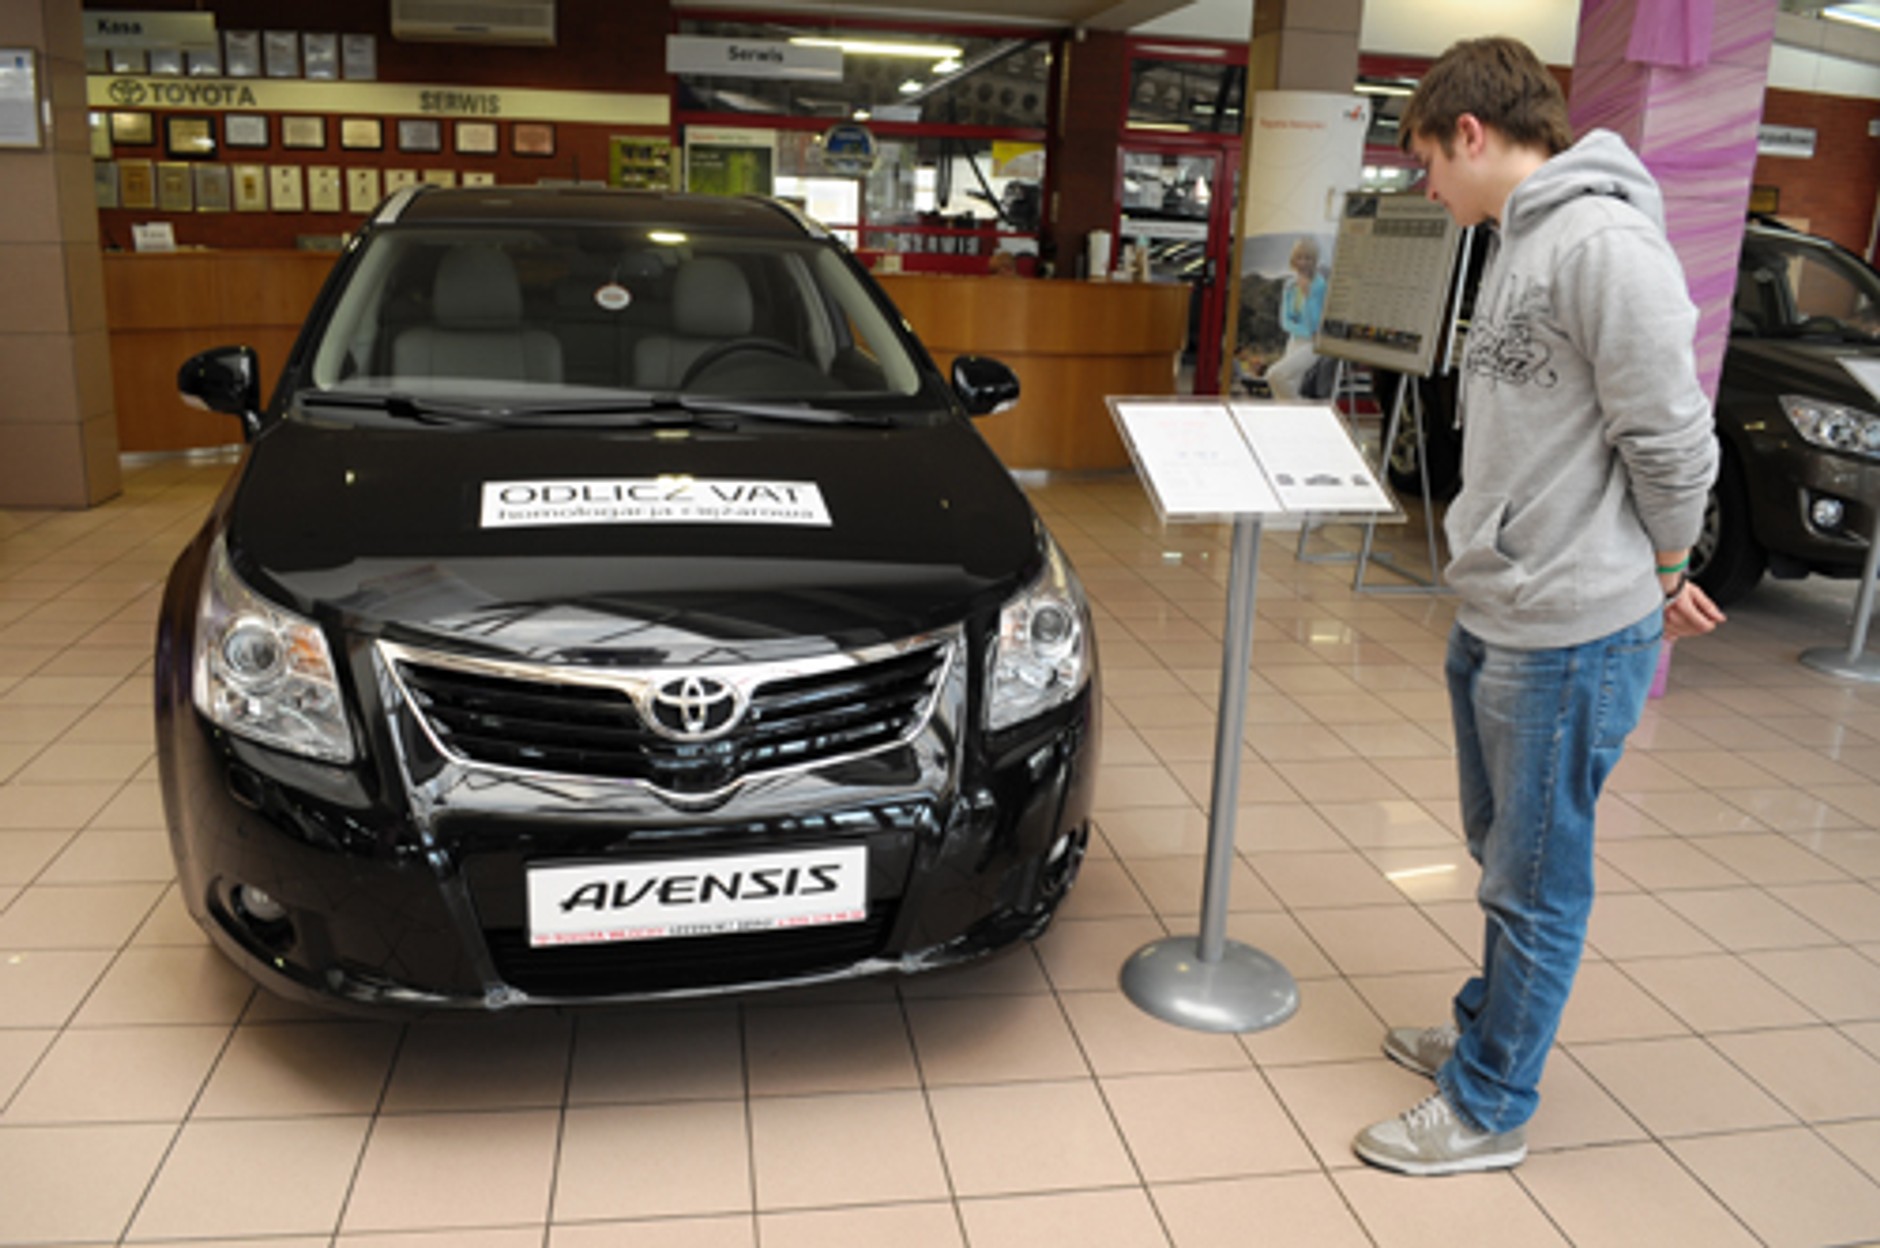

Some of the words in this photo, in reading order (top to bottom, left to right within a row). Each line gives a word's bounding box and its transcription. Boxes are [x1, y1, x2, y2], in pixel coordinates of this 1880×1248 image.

[97, 19, 142, 34] Kasa
[728, 45, 783, 62] Serwis
[148, 82, 256, 106] TOYOTA
[419, 89, 501, 114] SERWIS
[709, 484, 803, 503] VAT
[559, 864, 842, 913] AVENSIS
